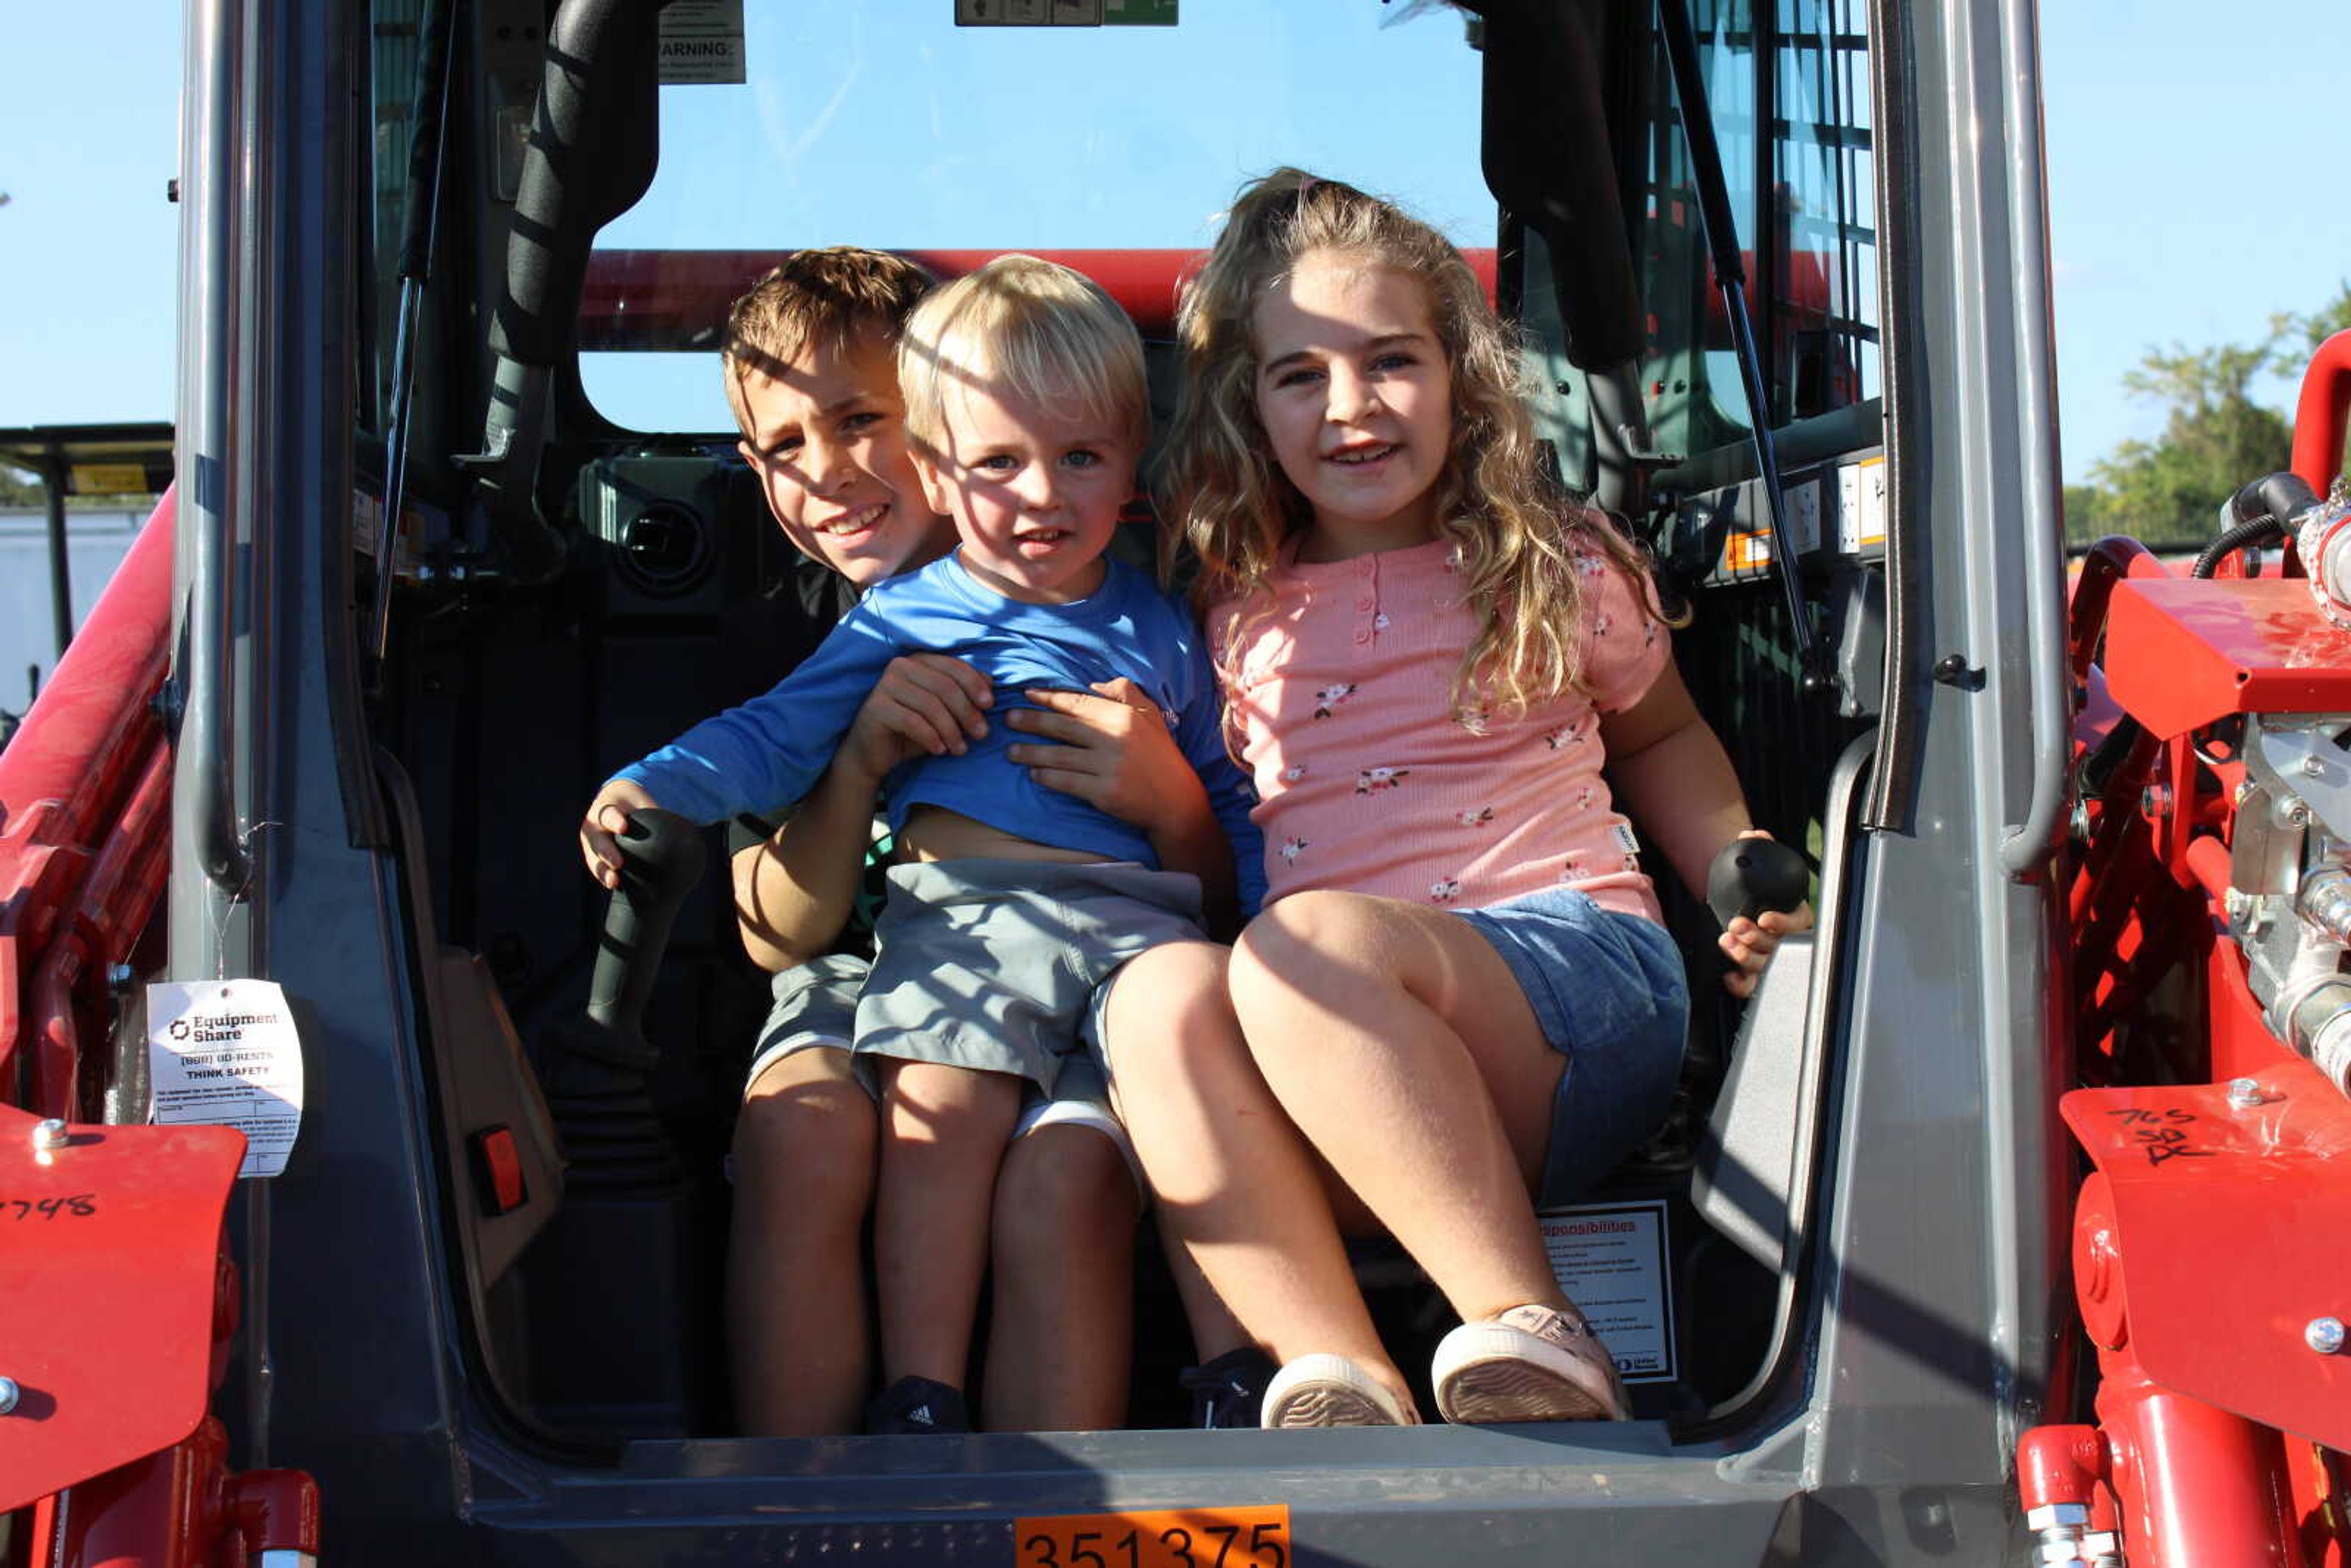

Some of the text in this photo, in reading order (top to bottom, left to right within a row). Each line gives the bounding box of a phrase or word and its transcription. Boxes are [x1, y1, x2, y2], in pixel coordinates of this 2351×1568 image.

[661, 41, 734, 56] ARNING:
[193, 1013, 278, 1029] Equipment
[193, 1029, 242, 1042] Share
[187, 1067, 269, 1079] THINK SAFETY
[1024, 1523, 1284, 1568] 351375
